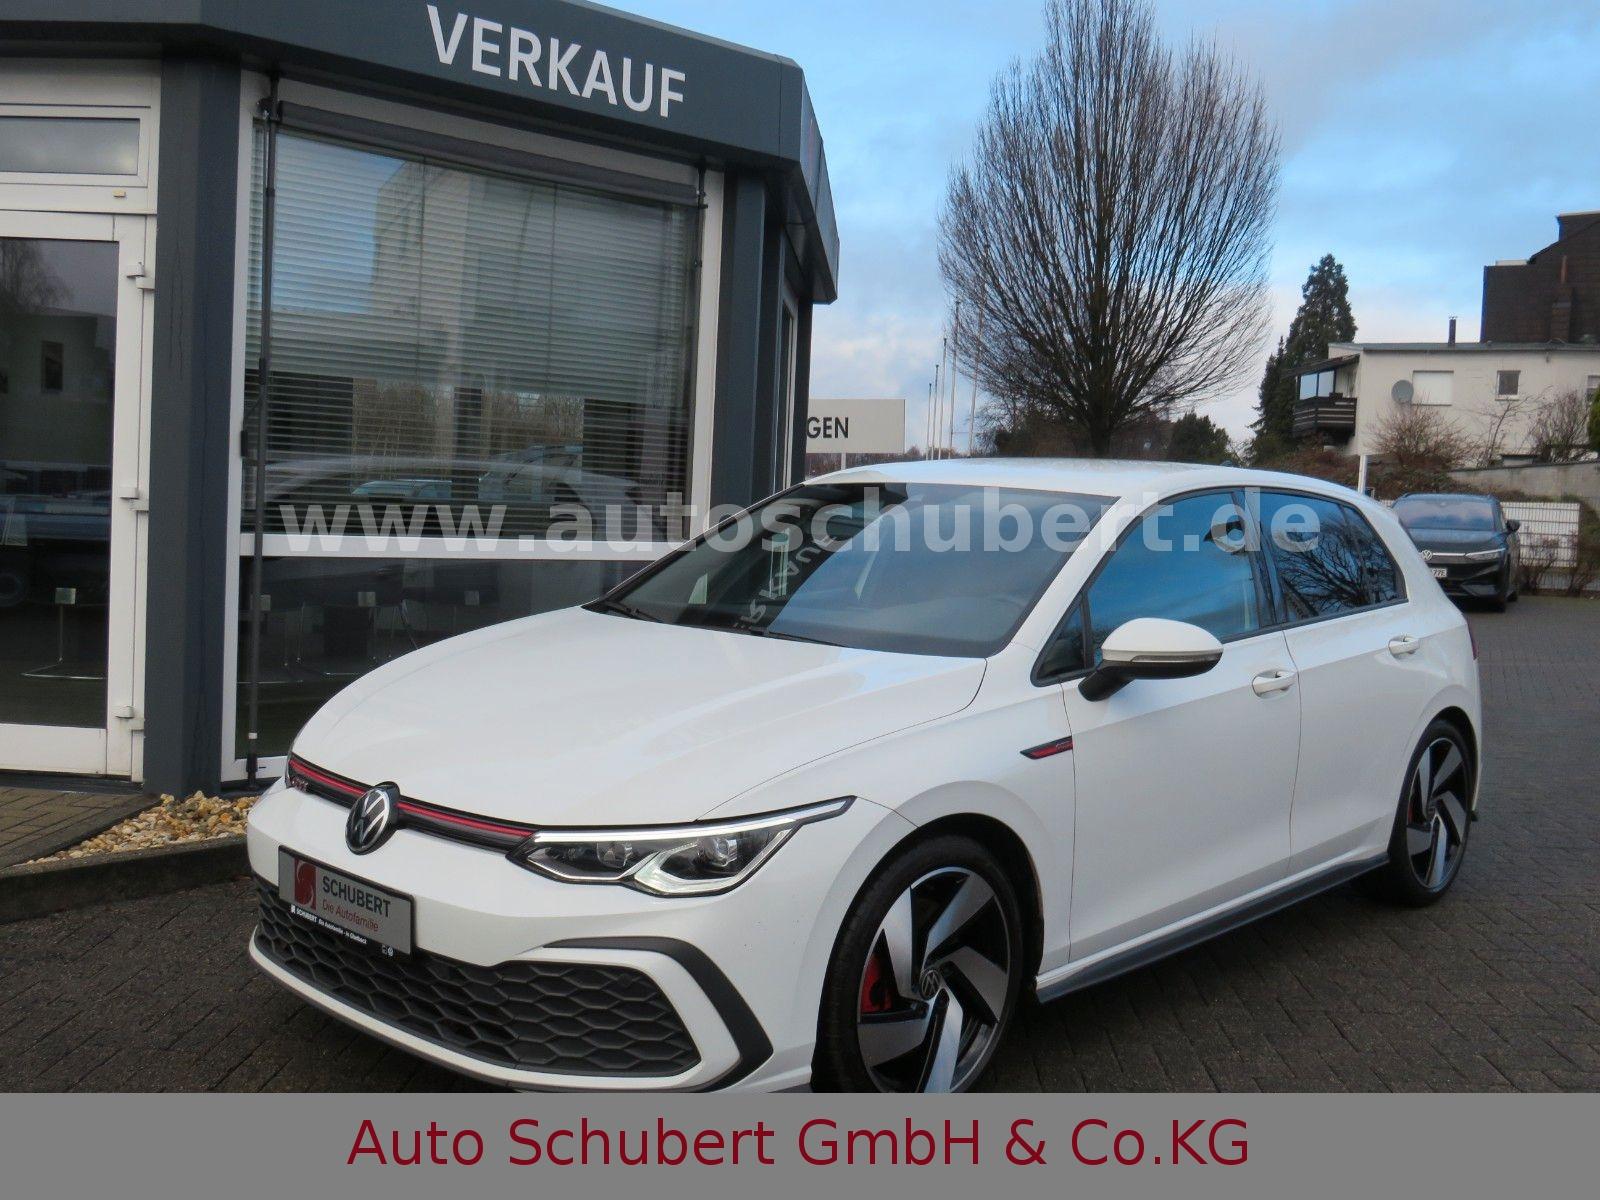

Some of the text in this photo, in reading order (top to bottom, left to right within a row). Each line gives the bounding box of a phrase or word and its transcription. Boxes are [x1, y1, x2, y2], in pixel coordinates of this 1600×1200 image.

[427, 4, 686, 118] VERKAUF
[806, 416, 849, 439] GEN
[322, 875, 391, 917] SCHUBERT
[296, 907, 317, 923] SCHUBERT
[322, 899, 379, 931] Die Autofamilie
